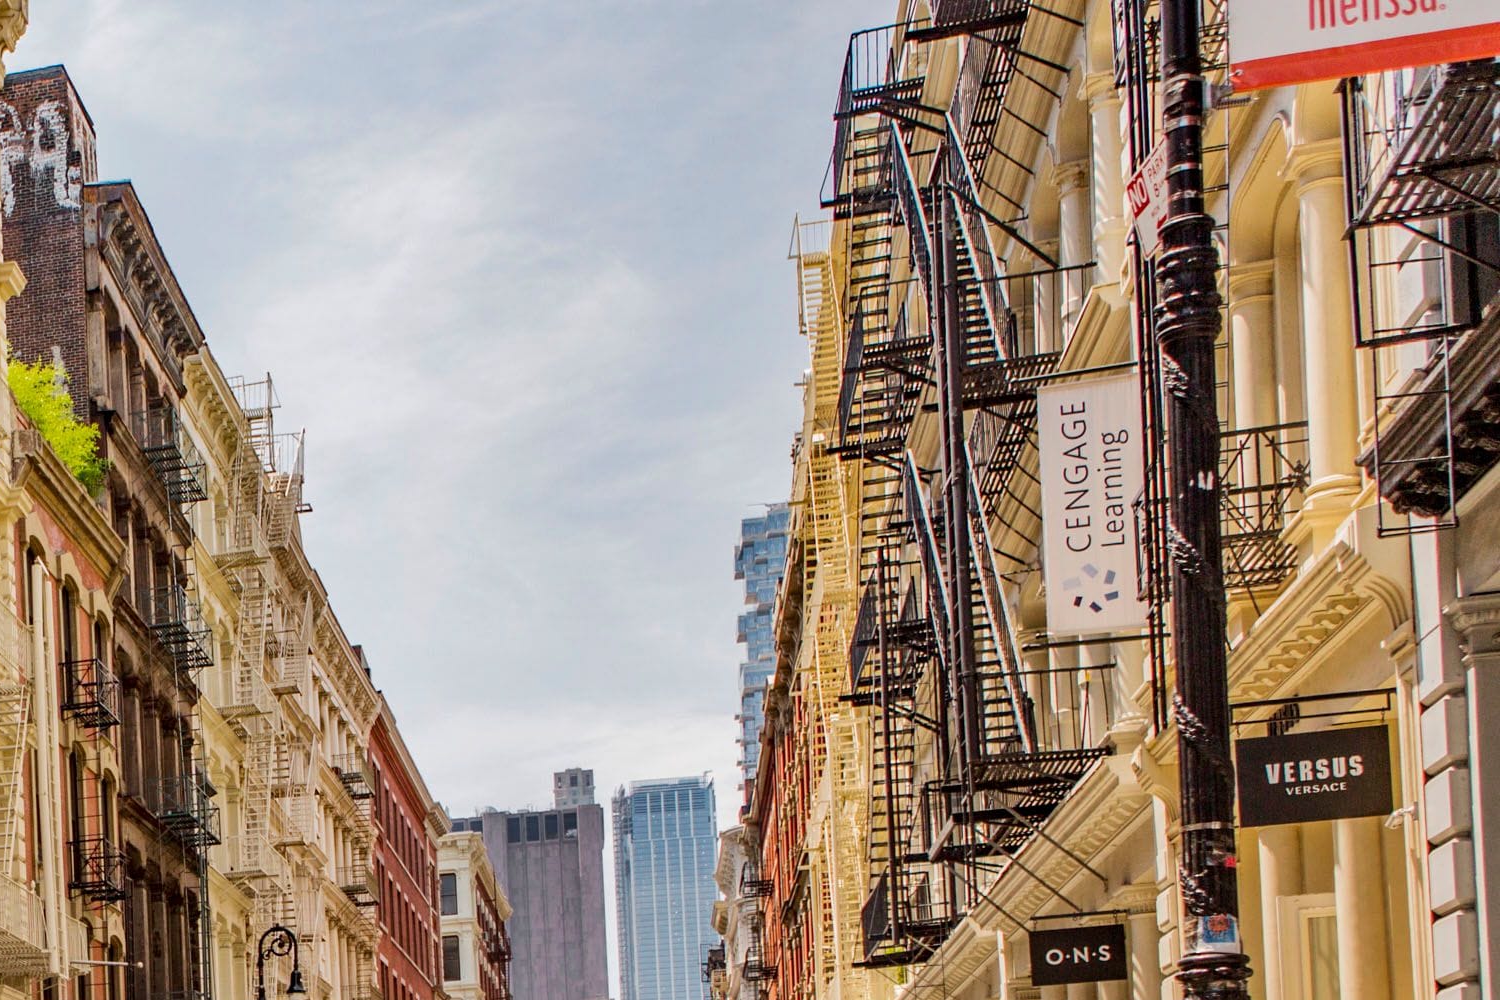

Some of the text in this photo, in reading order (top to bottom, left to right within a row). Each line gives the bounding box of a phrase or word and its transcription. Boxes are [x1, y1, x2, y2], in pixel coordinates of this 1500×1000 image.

[1128, 178, 1149, 214] NO
[1060, 401, 1092, 552] CENGAGE
[1097, 428, 1129, 548] Learning
[1265, 754, 1364, 785] VERSUS
[1285, 781, 1348, 796] VERSACE
